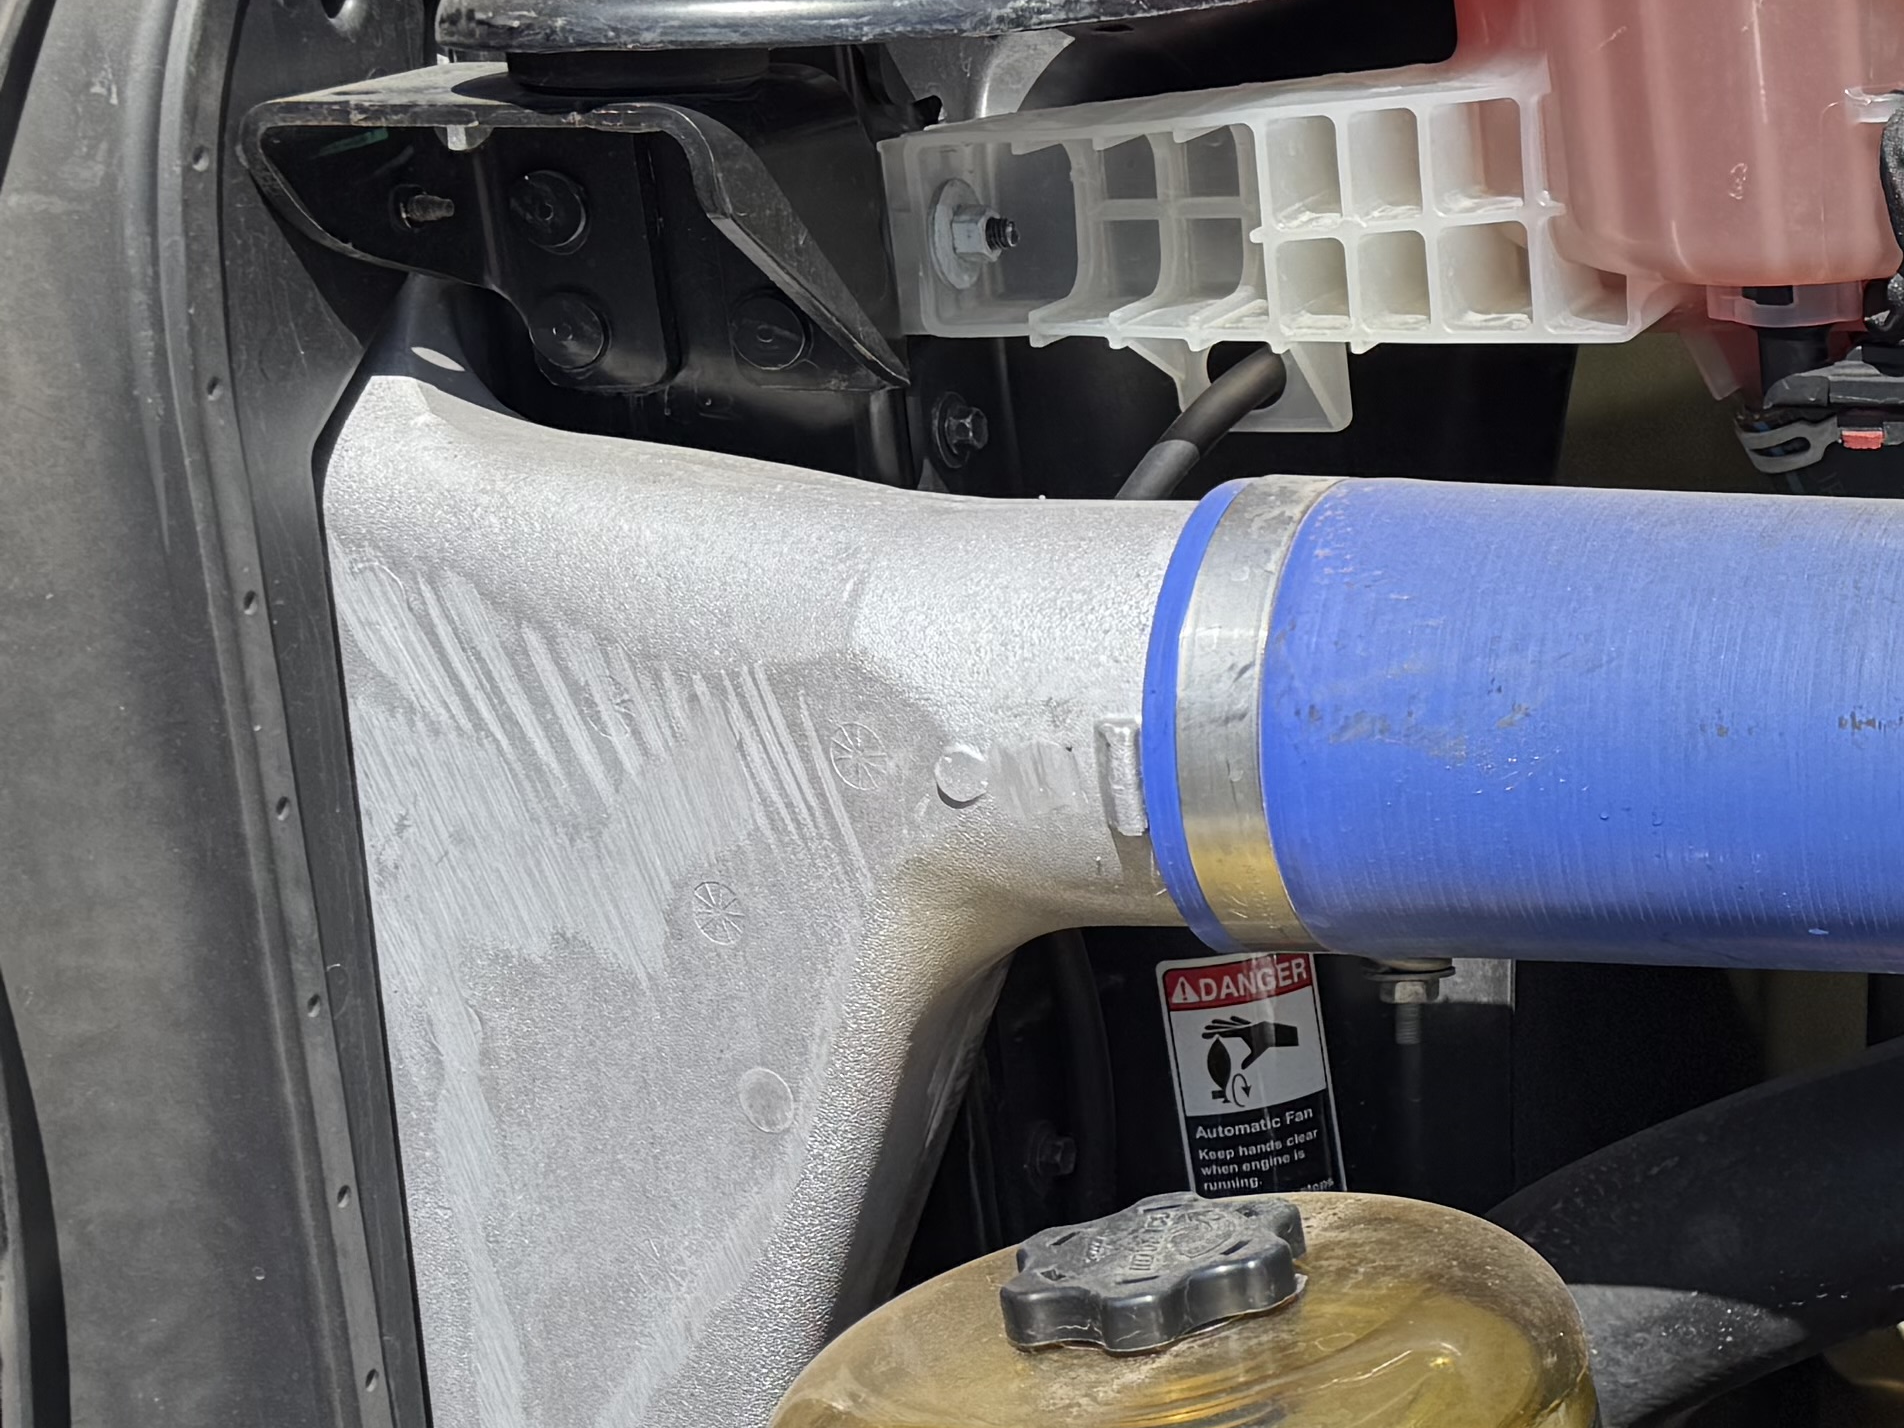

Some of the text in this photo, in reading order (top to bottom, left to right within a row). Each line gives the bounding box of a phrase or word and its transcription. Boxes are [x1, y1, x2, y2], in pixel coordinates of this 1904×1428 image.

[1198, 957, 1307, 1002] DANGER
[1195, 1108, 1313, 1140] Automatic Fan
[1199, 1128, 1318, 1162] Keep hands clear
[1200, 1149, 1306, 1176] when engine is
[1203, 1177, 1263, 1191] running.
